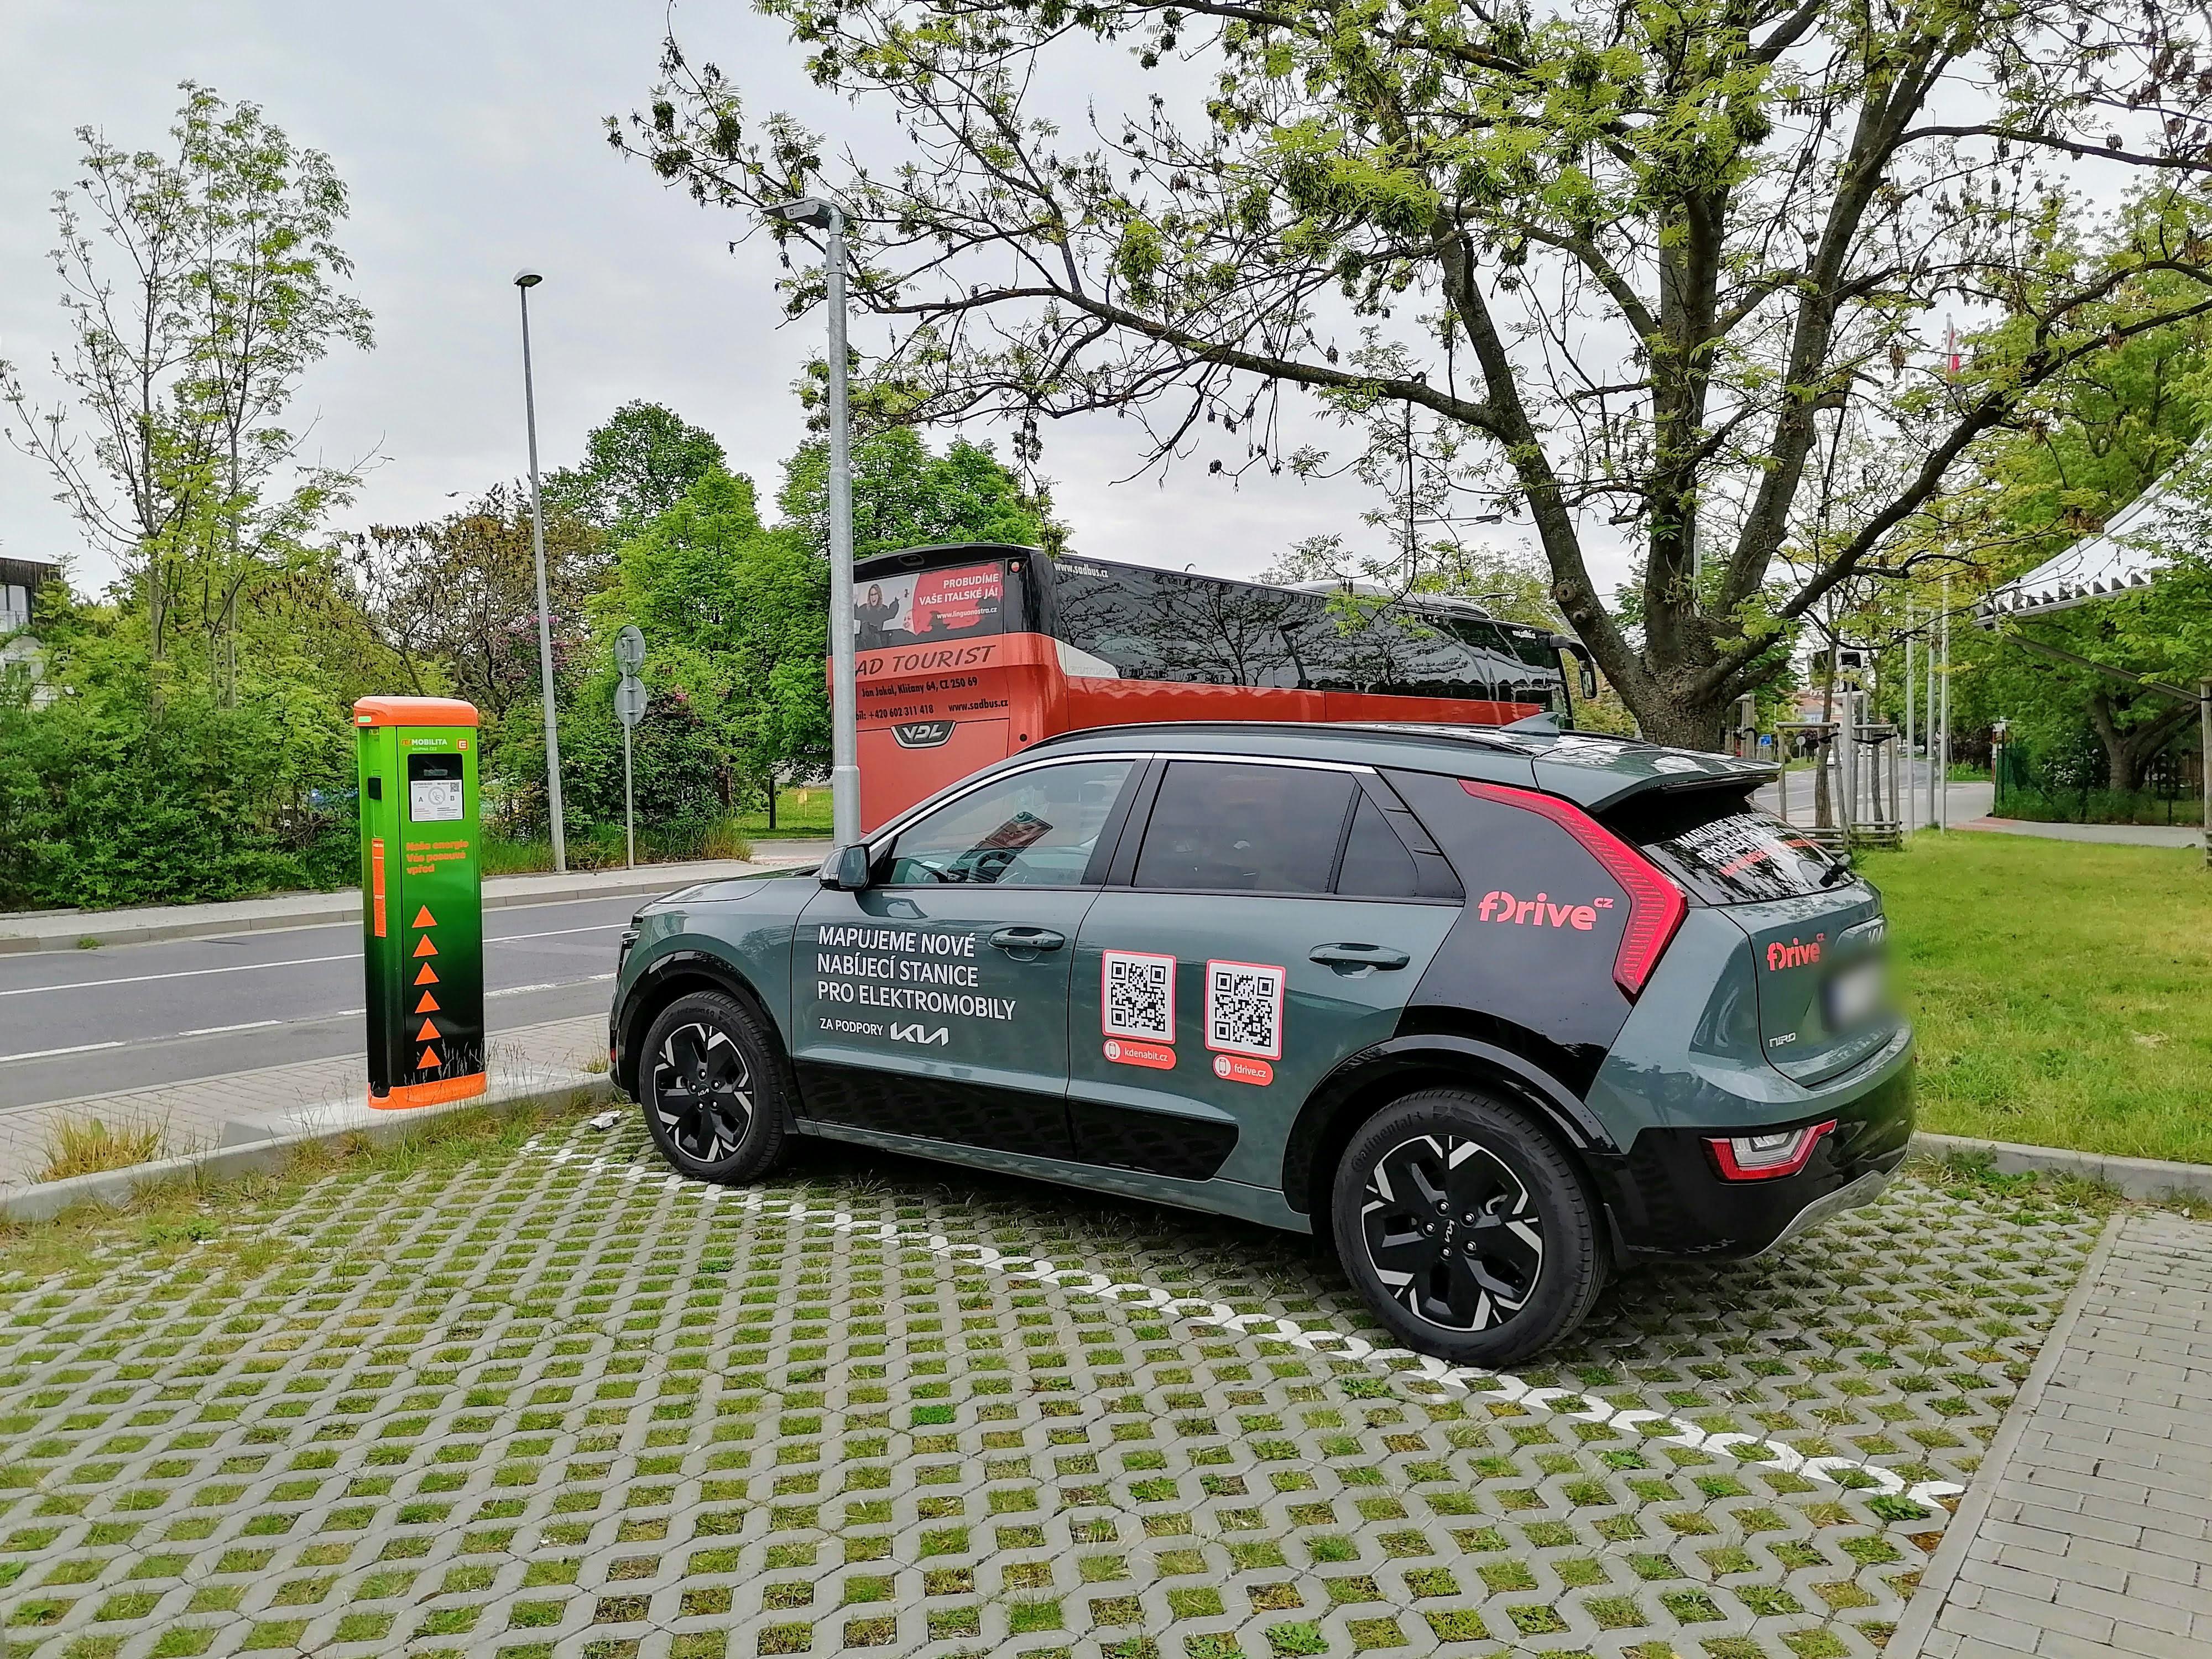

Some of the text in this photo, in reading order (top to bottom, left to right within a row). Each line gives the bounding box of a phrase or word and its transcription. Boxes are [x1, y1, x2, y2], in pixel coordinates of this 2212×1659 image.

[1053, 562, 1109, 578] www.sadbus.cz
[943, 572, 999, 589] PROBUDÍME
[919, 585, 998, 606] VAŠE ITALSKÉ JÁ!
[937, 607, 998, 619] www.linguanostra.cz
[855, 645, 996, 677] AD TOURIST
[926, 681, 938, 692] 64,
[940, 680, 950, 690] CZ
[950, 677, 966, 688] 250
[968, 676, 978, 686] 69
[869, 708, 888, 719] +420
[889, 707, 902, 717] 602
[904, 706, 917, 716] 311
[920, 704, 933, 714] 418
[948, 698, 1009, 712] www.sadbus.cz
[902, 724, 943, 740] VDL
[818, 926, 975, 957] MAPUJEME NOVÉ
[817, 952, 979, 987] NABÍJECÍ STANICE
[817, 981, 1016, 1020] PRO ELEKTROMOBILY
[820, 1018, 950, 1046] ZA PODPORY KIA
[1124, 1047, 1168, 1062] kdenabit.cz
[1234, 1063, 1266, 1078] fdrive.cz
